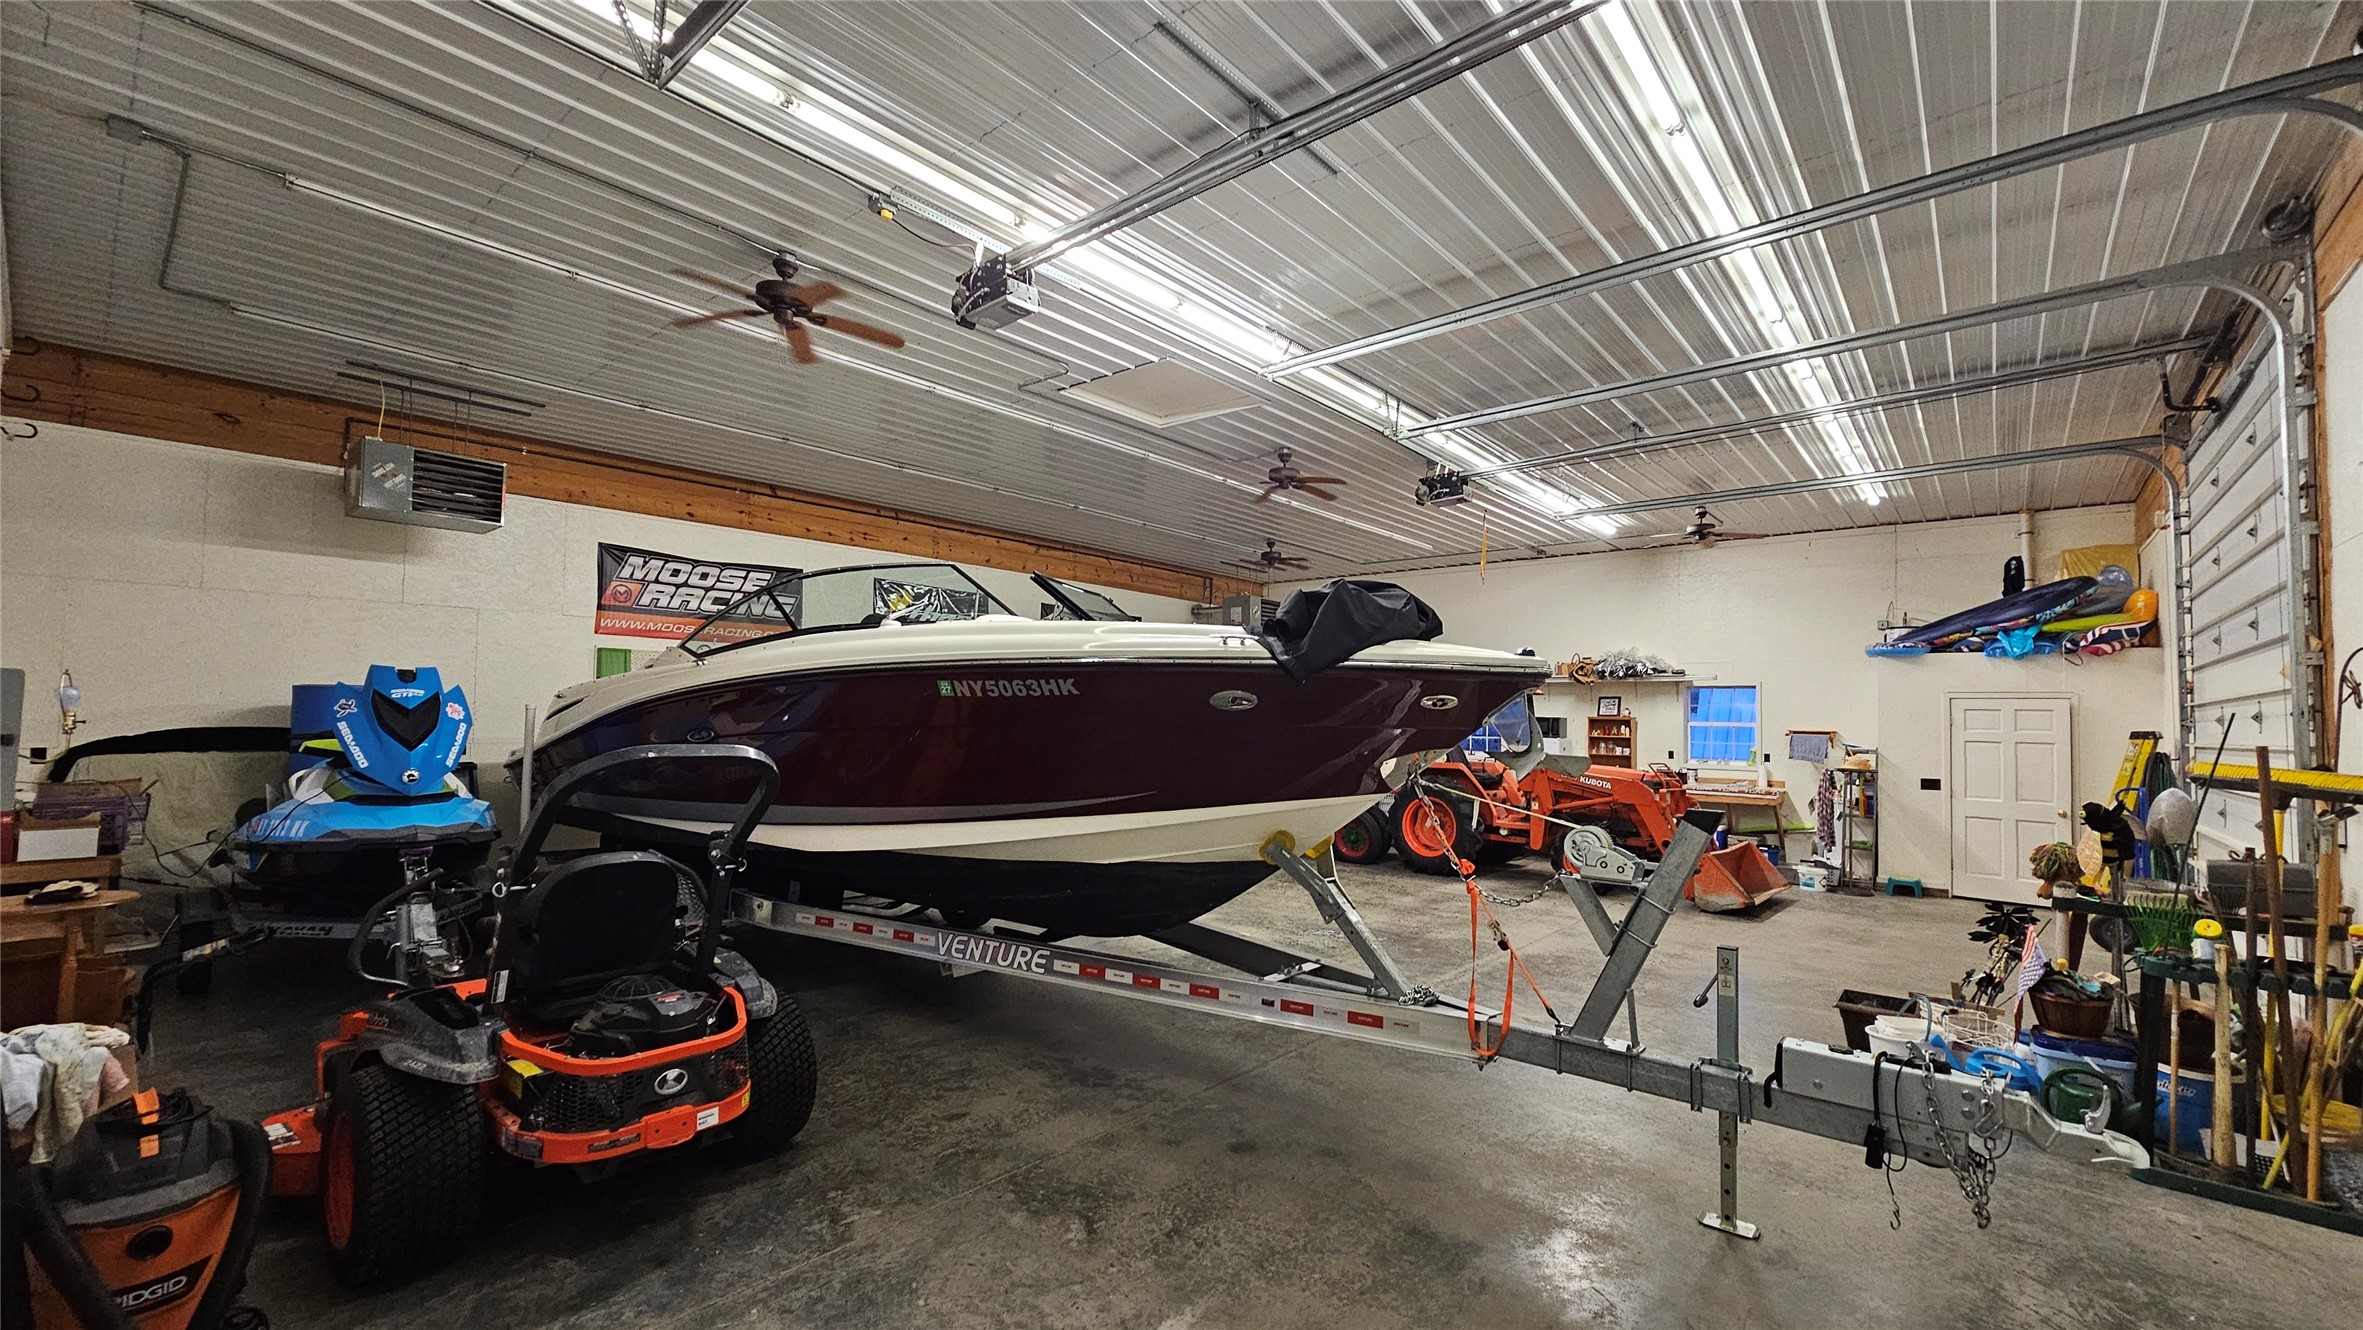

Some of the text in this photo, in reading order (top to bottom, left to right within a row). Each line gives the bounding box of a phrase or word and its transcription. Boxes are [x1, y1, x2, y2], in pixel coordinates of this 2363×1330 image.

[617, 554, 774, 593] MOOSE
[636, 583, 799, 619] RACING
[953, 678, 1080, 697] NY5063HK
[1579, 776, 1612, 789] KUBOTA
[937, 931, 1051, 974] VENTURE
